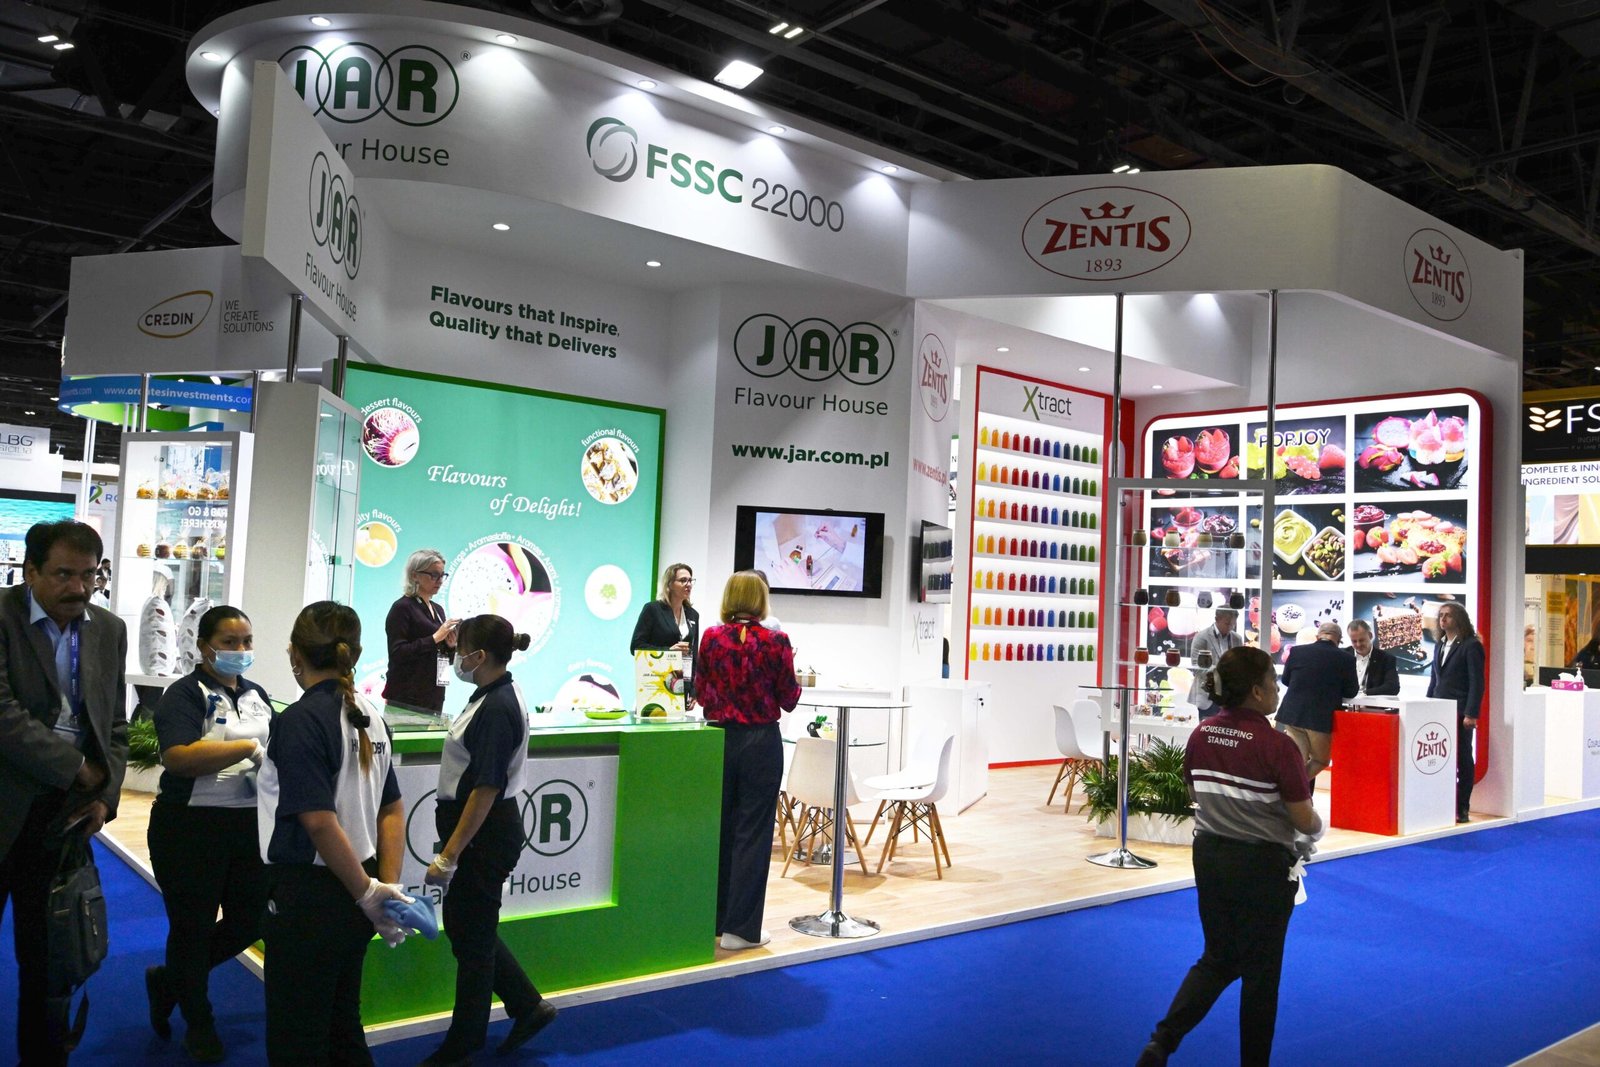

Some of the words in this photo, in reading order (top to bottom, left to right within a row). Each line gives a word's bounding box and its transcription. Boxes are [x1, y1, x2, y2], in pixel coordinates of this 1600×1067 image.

[362, 139, 449, 166] House
[646, 143, 744, 203] FSSC
[751, 178, 844, 232] 22000
[316, 170, 358, 268] JAR
[1041, 215, 1170, 255] ZENTIS
[1085, 258, 1122, 273] 1893
[1412, 248, 1465, 304] ZENTIS
[305, 252, 335, 299] Flavour
[335, 284, 357, 321] House
[224, 310, 259, 322] CREATE
[225, 300, 240, 310] WE
[431, 285, 513, 316] Flavours
[518, 303, 555, 324] that
[144, 312, 194, 326] CREDIN
[223, 321, 274, 334] SOLUTIONS
[429, 310, 501, 340] Quality
[505, 324, 544, 346] that
[547, 332, 618, 359] Delivers
[756, 325, 879, 375] JAR
[921, 353, 947, 404] ZENTIS
[391, 398, 422, 423] flavours
[734, 387, 815, 410] Flavour
[822, 394, 889, 415] House
[1023, 386, 1072, 421] Xtract
[581, 428, 615, 447] functional
[616, 427, 640, 454] flavours
[732, 444, 889, 469] www.jar.com.pl
[427, 464, 508, 489] Flavours
[1520, 465, 1568, 475] COMPLETE
[1571, 464, 1578, 473] &
[1522, 476, 1580, 486] INGREDIENT
[490, 494, 513, 517] of
[512, 495, 582, 520] Delight!
[371, 509, 402, 534] flavours
[1200, 725, 1254, 740] HOUSEKEEPING
[1207, 735, 1240, 748] STANDBY
[1416, 738, 1447, 761] ZENTIS
[510, 872, 581, 896] House
